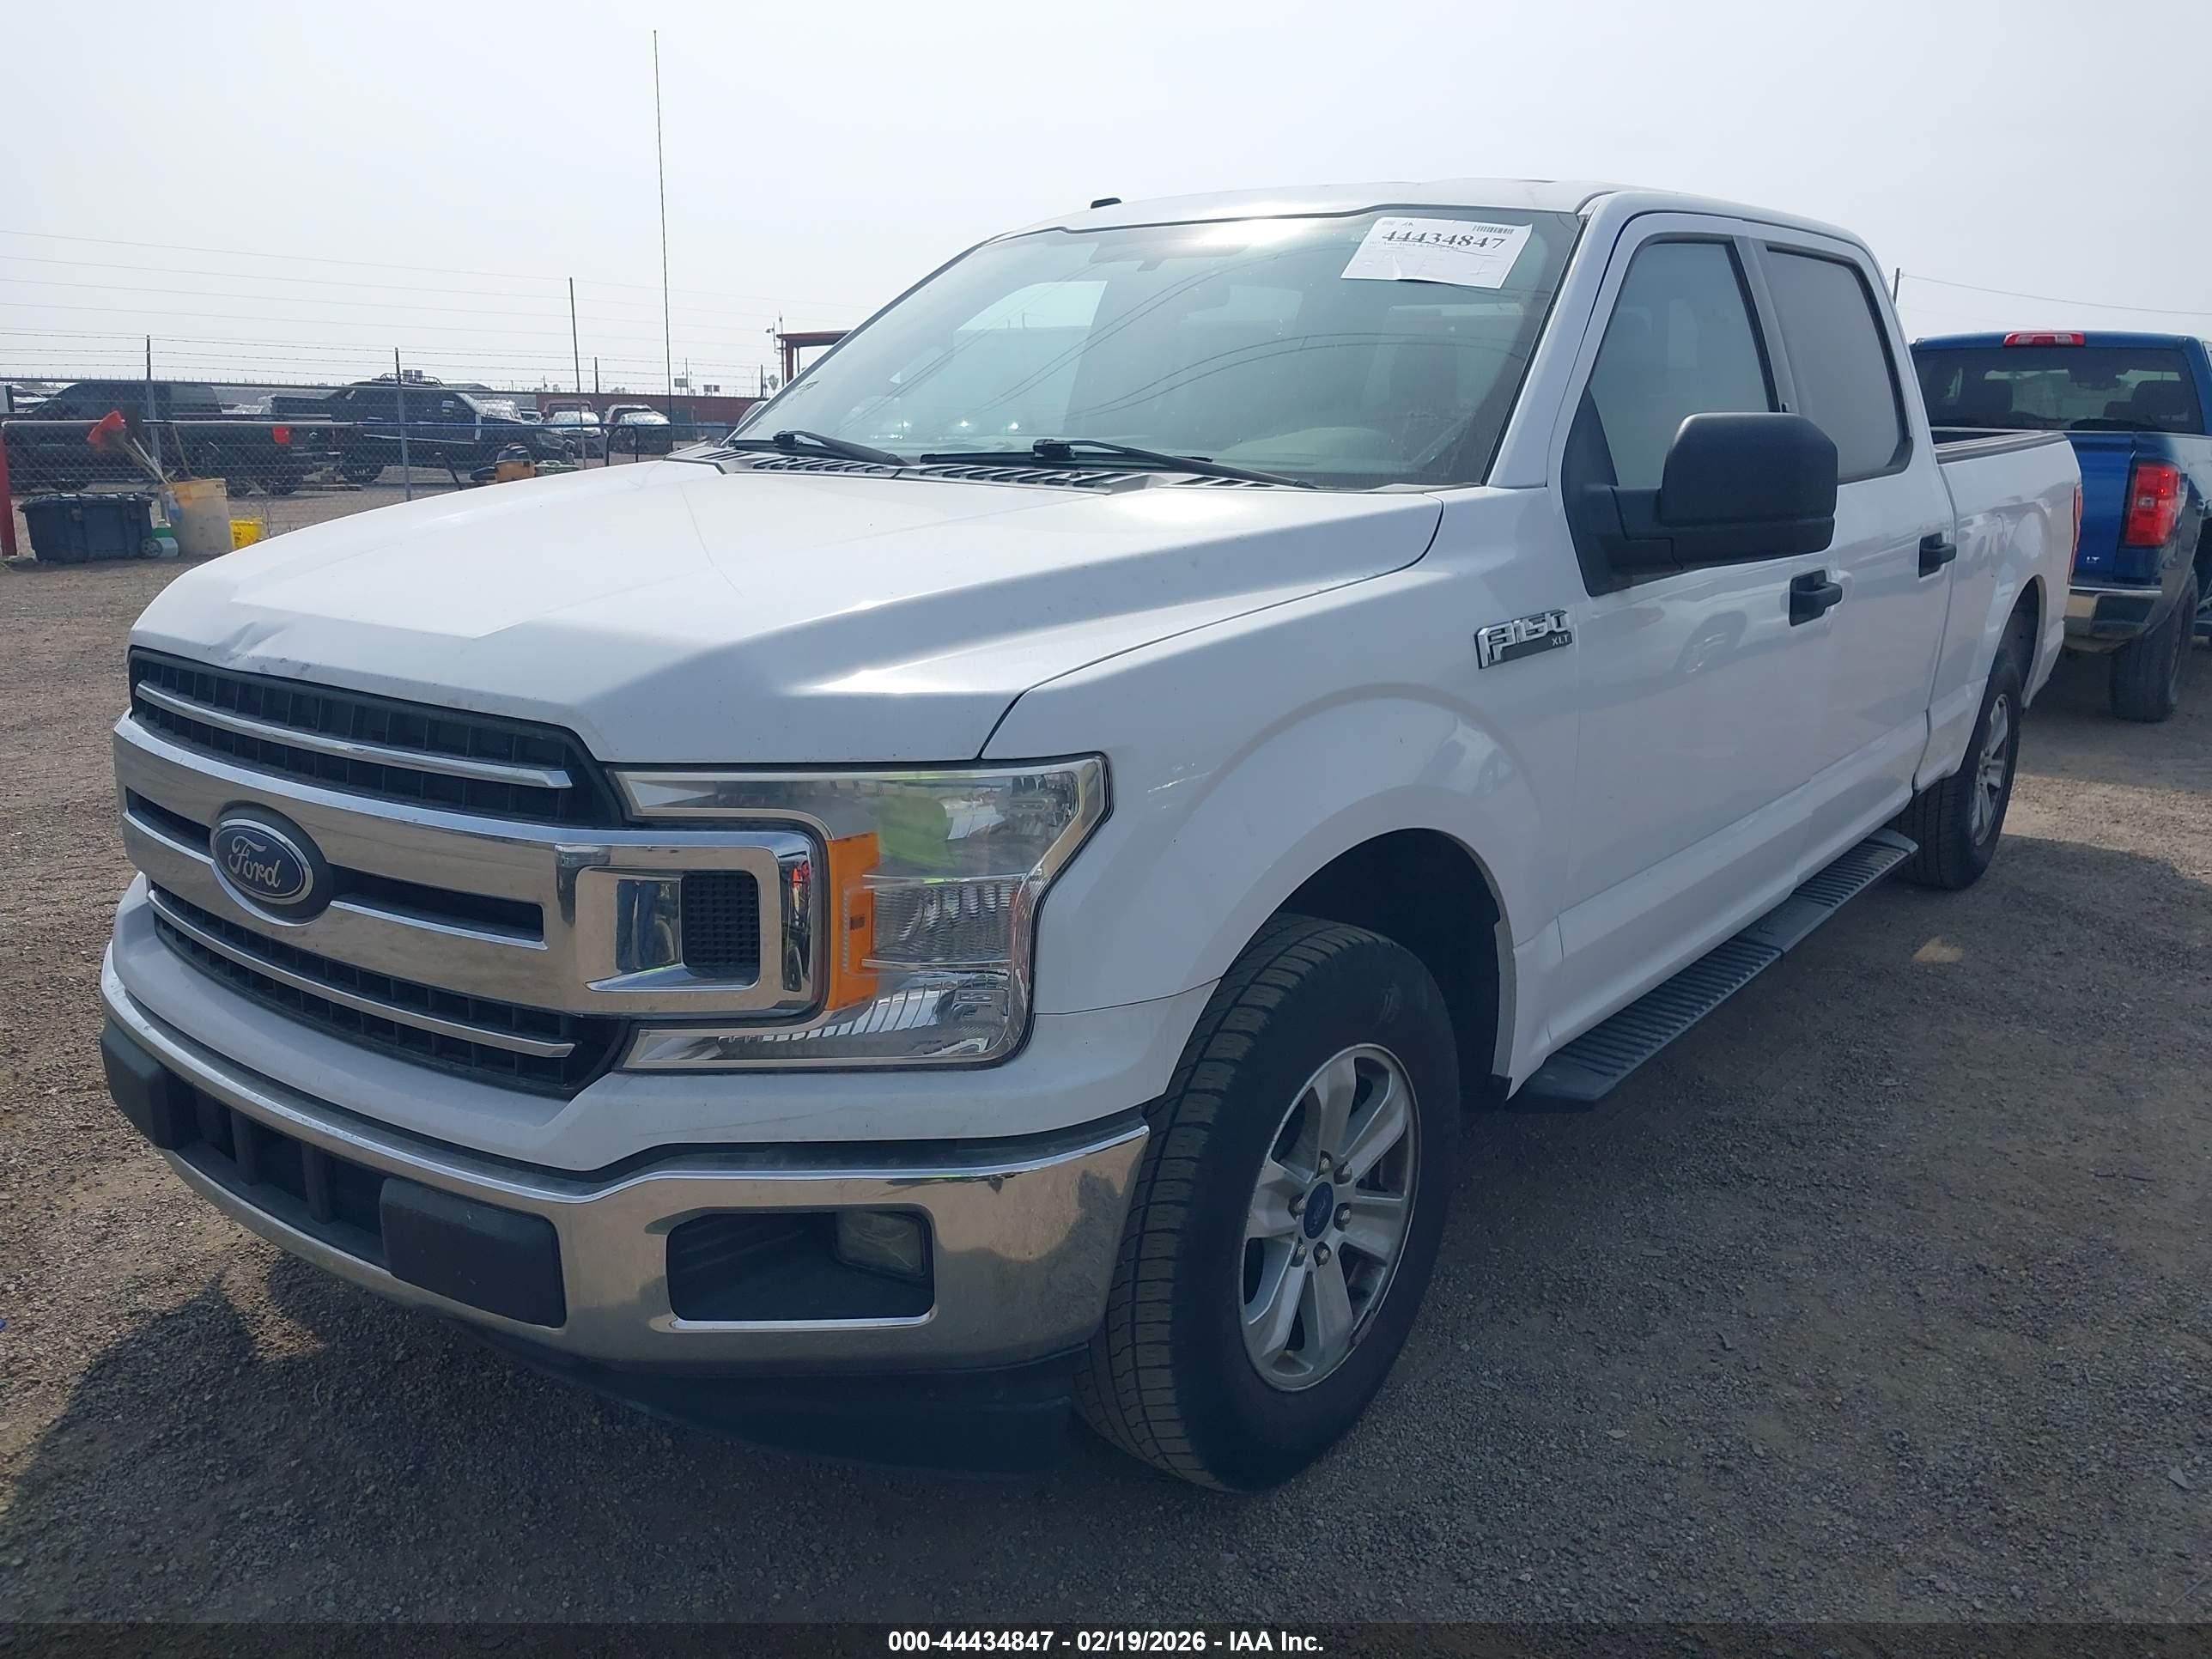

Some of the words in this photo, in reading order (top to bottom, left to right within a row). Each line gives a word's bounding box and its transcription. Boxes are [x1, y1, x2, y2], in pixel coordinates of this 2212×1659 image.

[1381, 230, 1507, 249] 44434847
[1552, 635, 1569, 647] XLT
[228, 836, 282, 889] Ford
